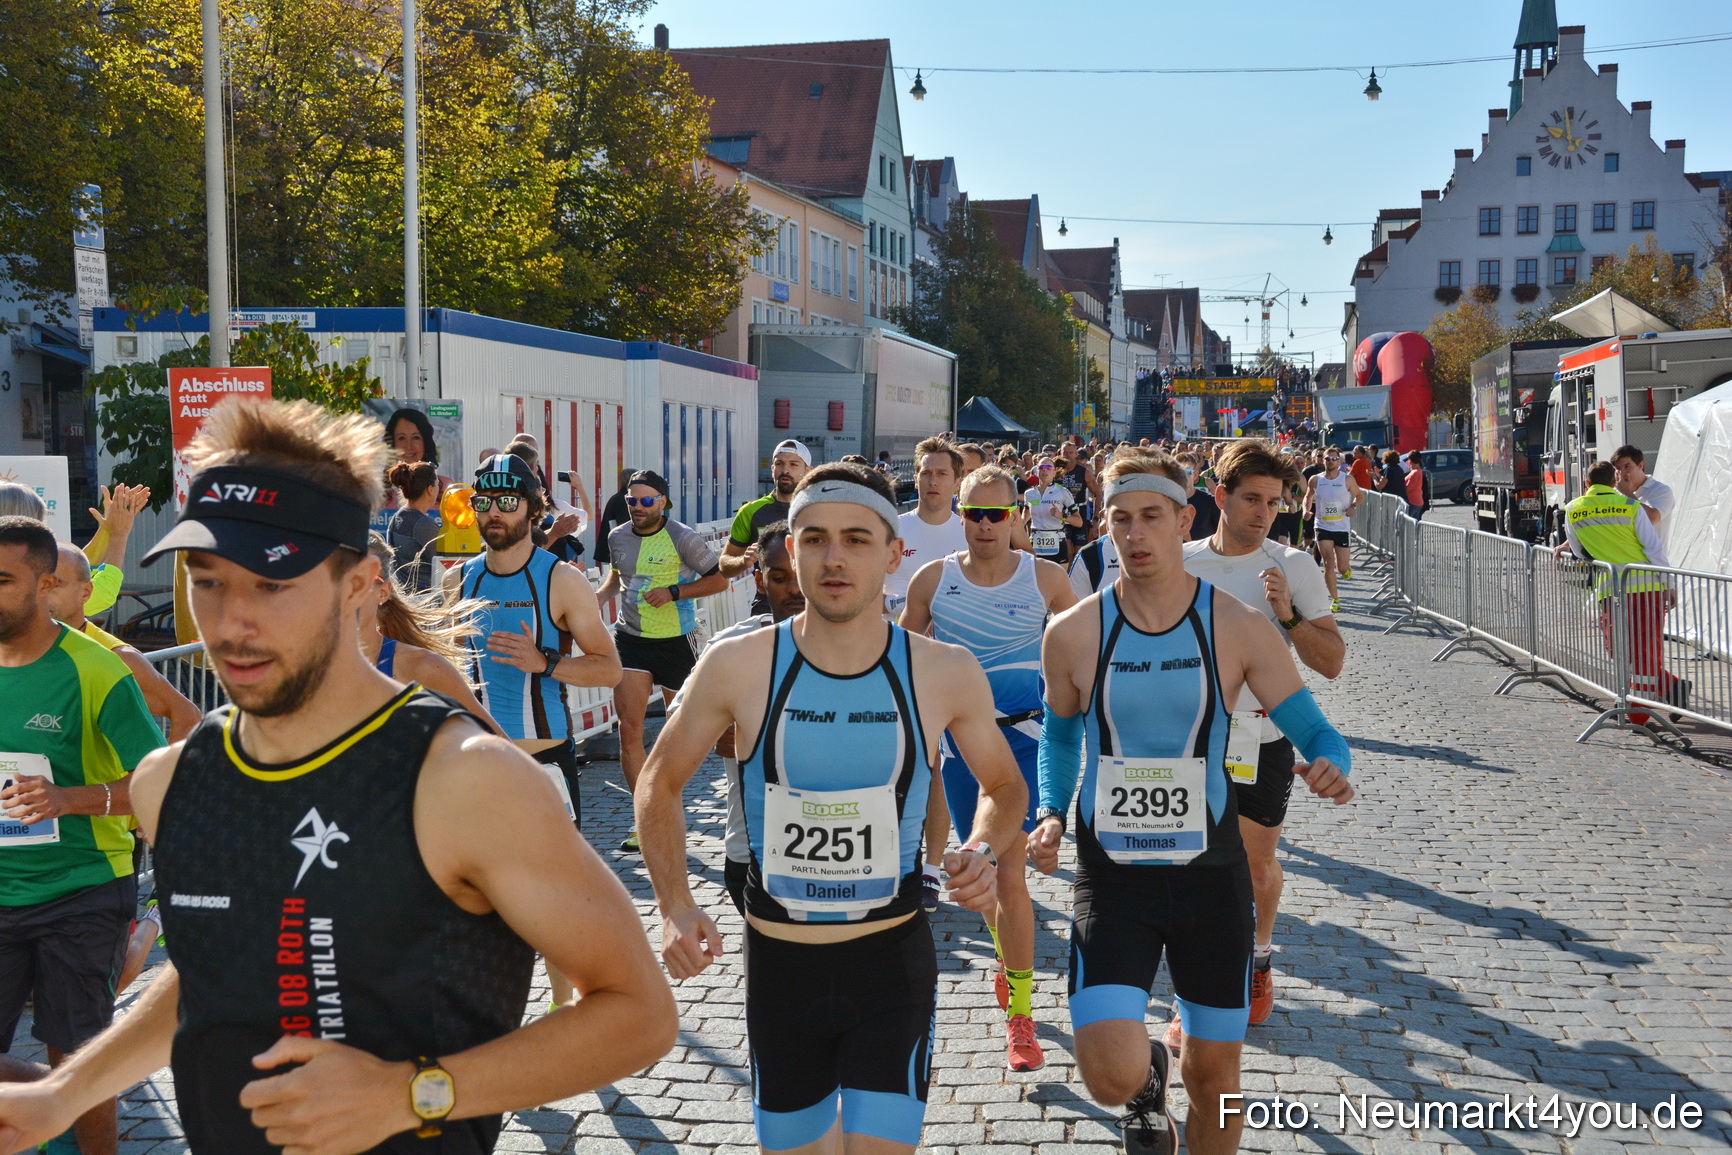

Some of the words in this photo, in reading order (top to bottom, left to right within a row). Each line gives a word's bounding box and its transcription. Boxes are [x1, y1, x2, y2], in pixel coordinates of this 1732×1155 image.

[81, 255, 90, 263] nur
[92, 256, 100, 264] mit
[78, 263, 105, 275] Parkschein
[81, 275, 104, 287] werktags
[2, 371, 11, 391] 3
[178, 377, 265, 393] Abschluss
[1205, 381, 1242, 390] START
[179, 394, 208, 403] statt
[480, 473, 522, 490] KULT
[1572, 506, 1628, 519] Org.-Leiter
[1036, 538, 1056, 546] 3128
[24, 713, 64, 730] AOK
[1124, 768, 1174, 779] BOCK
[802, 801, 860, 816] BOCK
[1110, 787, 1189, 818] 2393
[784, 822, 872, 862] 2251
[1124, 836, 1177, 849] Thomas
[792, 865, 819, 875] PARTL
[820, 867, 860, 876] Neumarkt
[806, 882, 856, 898] Daniel
[276, 898, 306, 965] ROTH
[310, 917, 347, 1041] TRIATHLON
[278, 973, 310, 1007] 08
